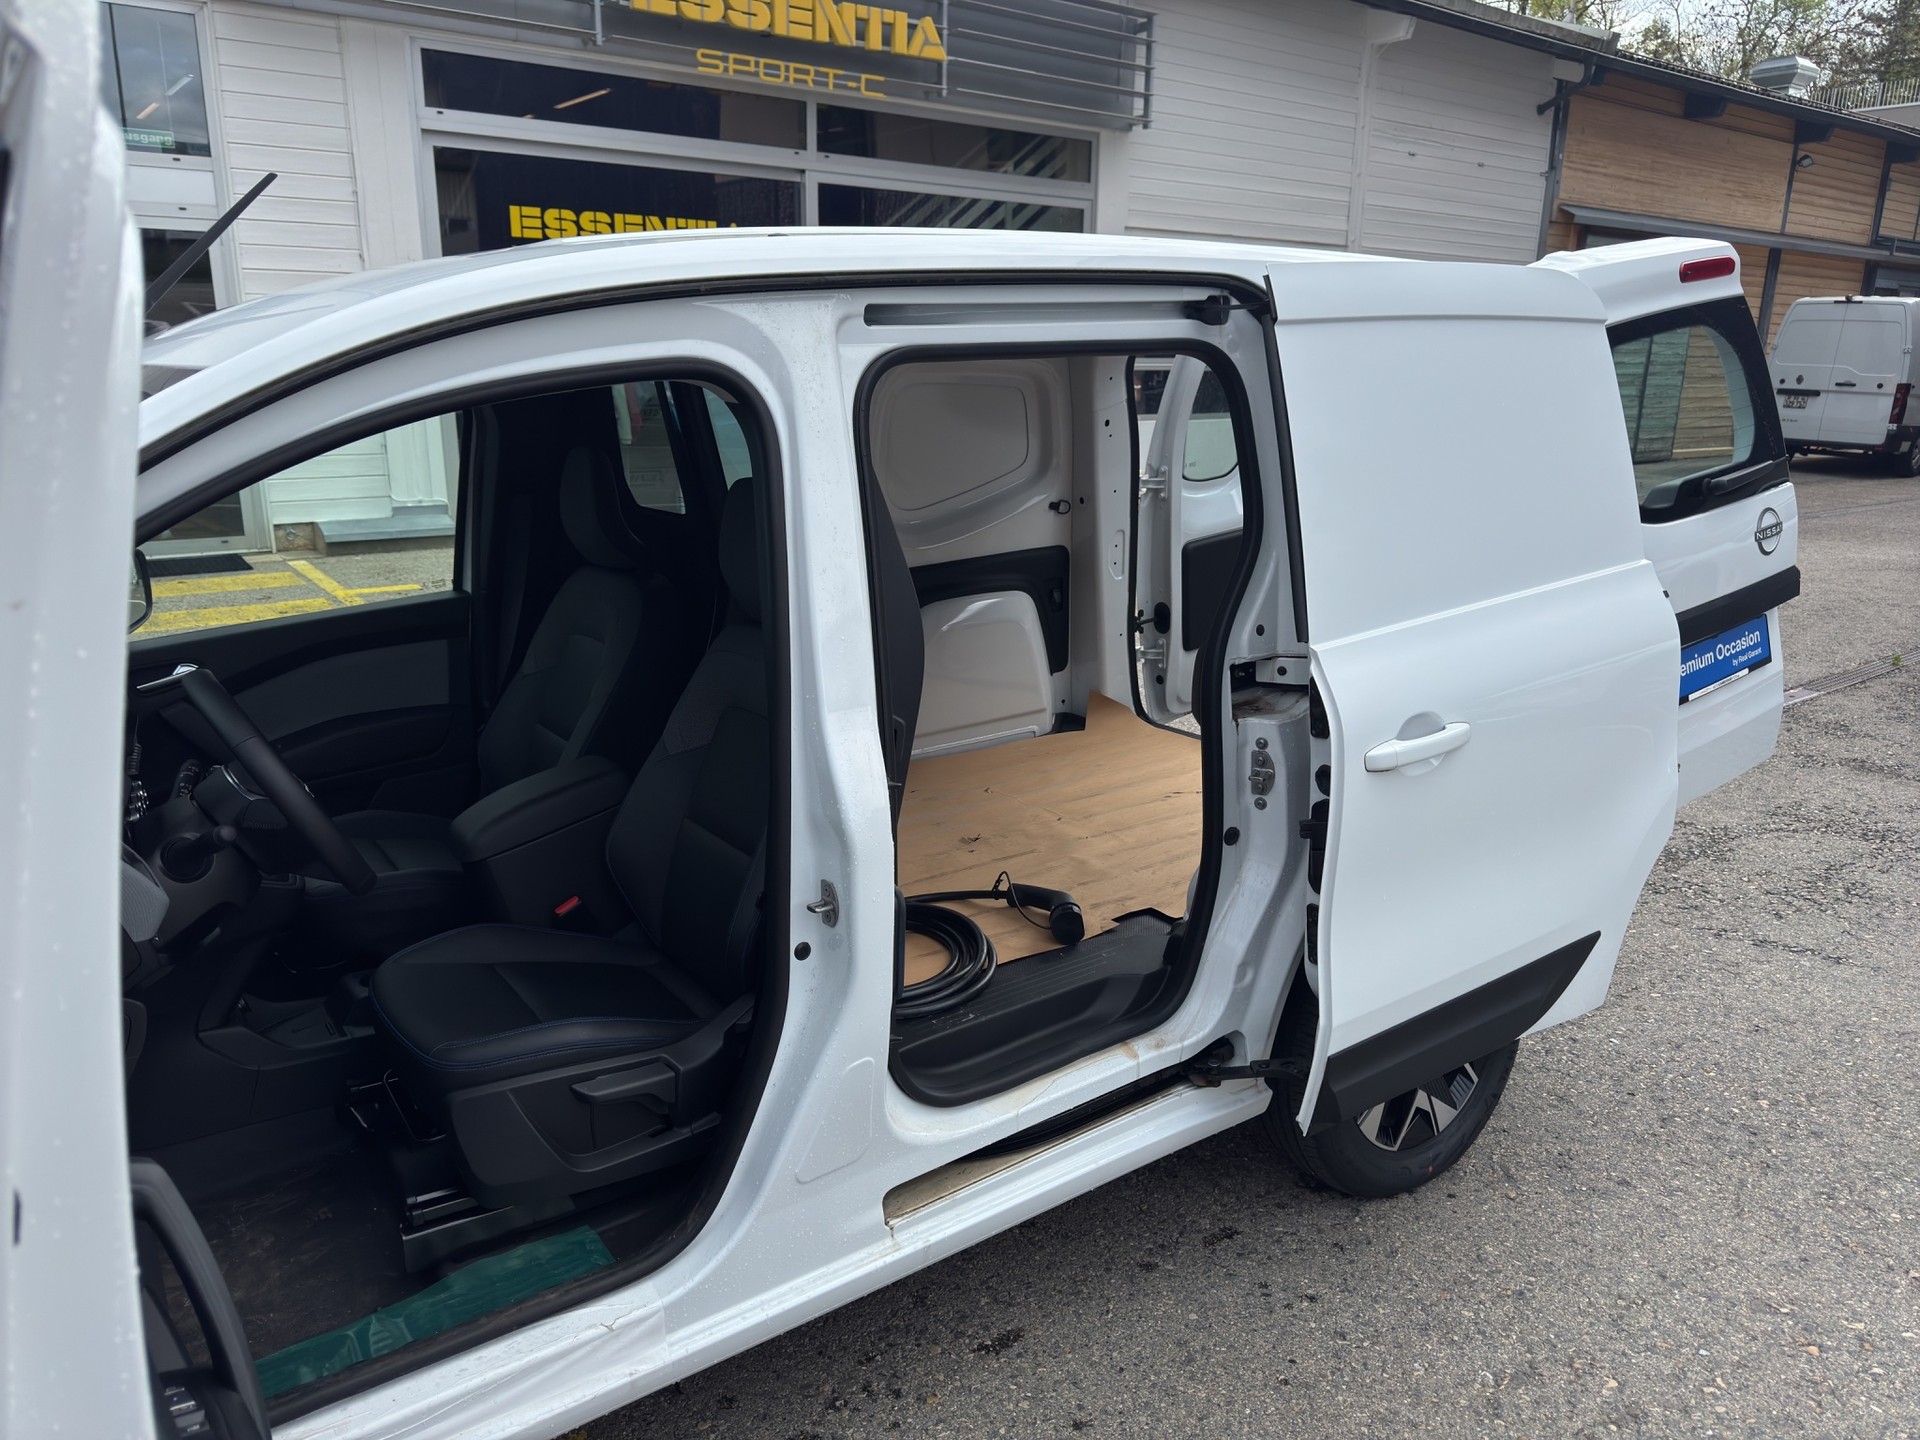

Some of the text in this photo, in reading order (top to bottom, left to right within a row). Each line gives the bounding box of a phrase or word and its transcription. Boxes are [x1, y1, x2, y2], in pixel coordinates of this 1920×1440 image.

[695, 47, 888, 99] SPORT-C
[124, 133, 172, 146] usgang
[1756, 524, 1783, 540] NISSA
[1680, 630, 1761, 676] emium Occasion
